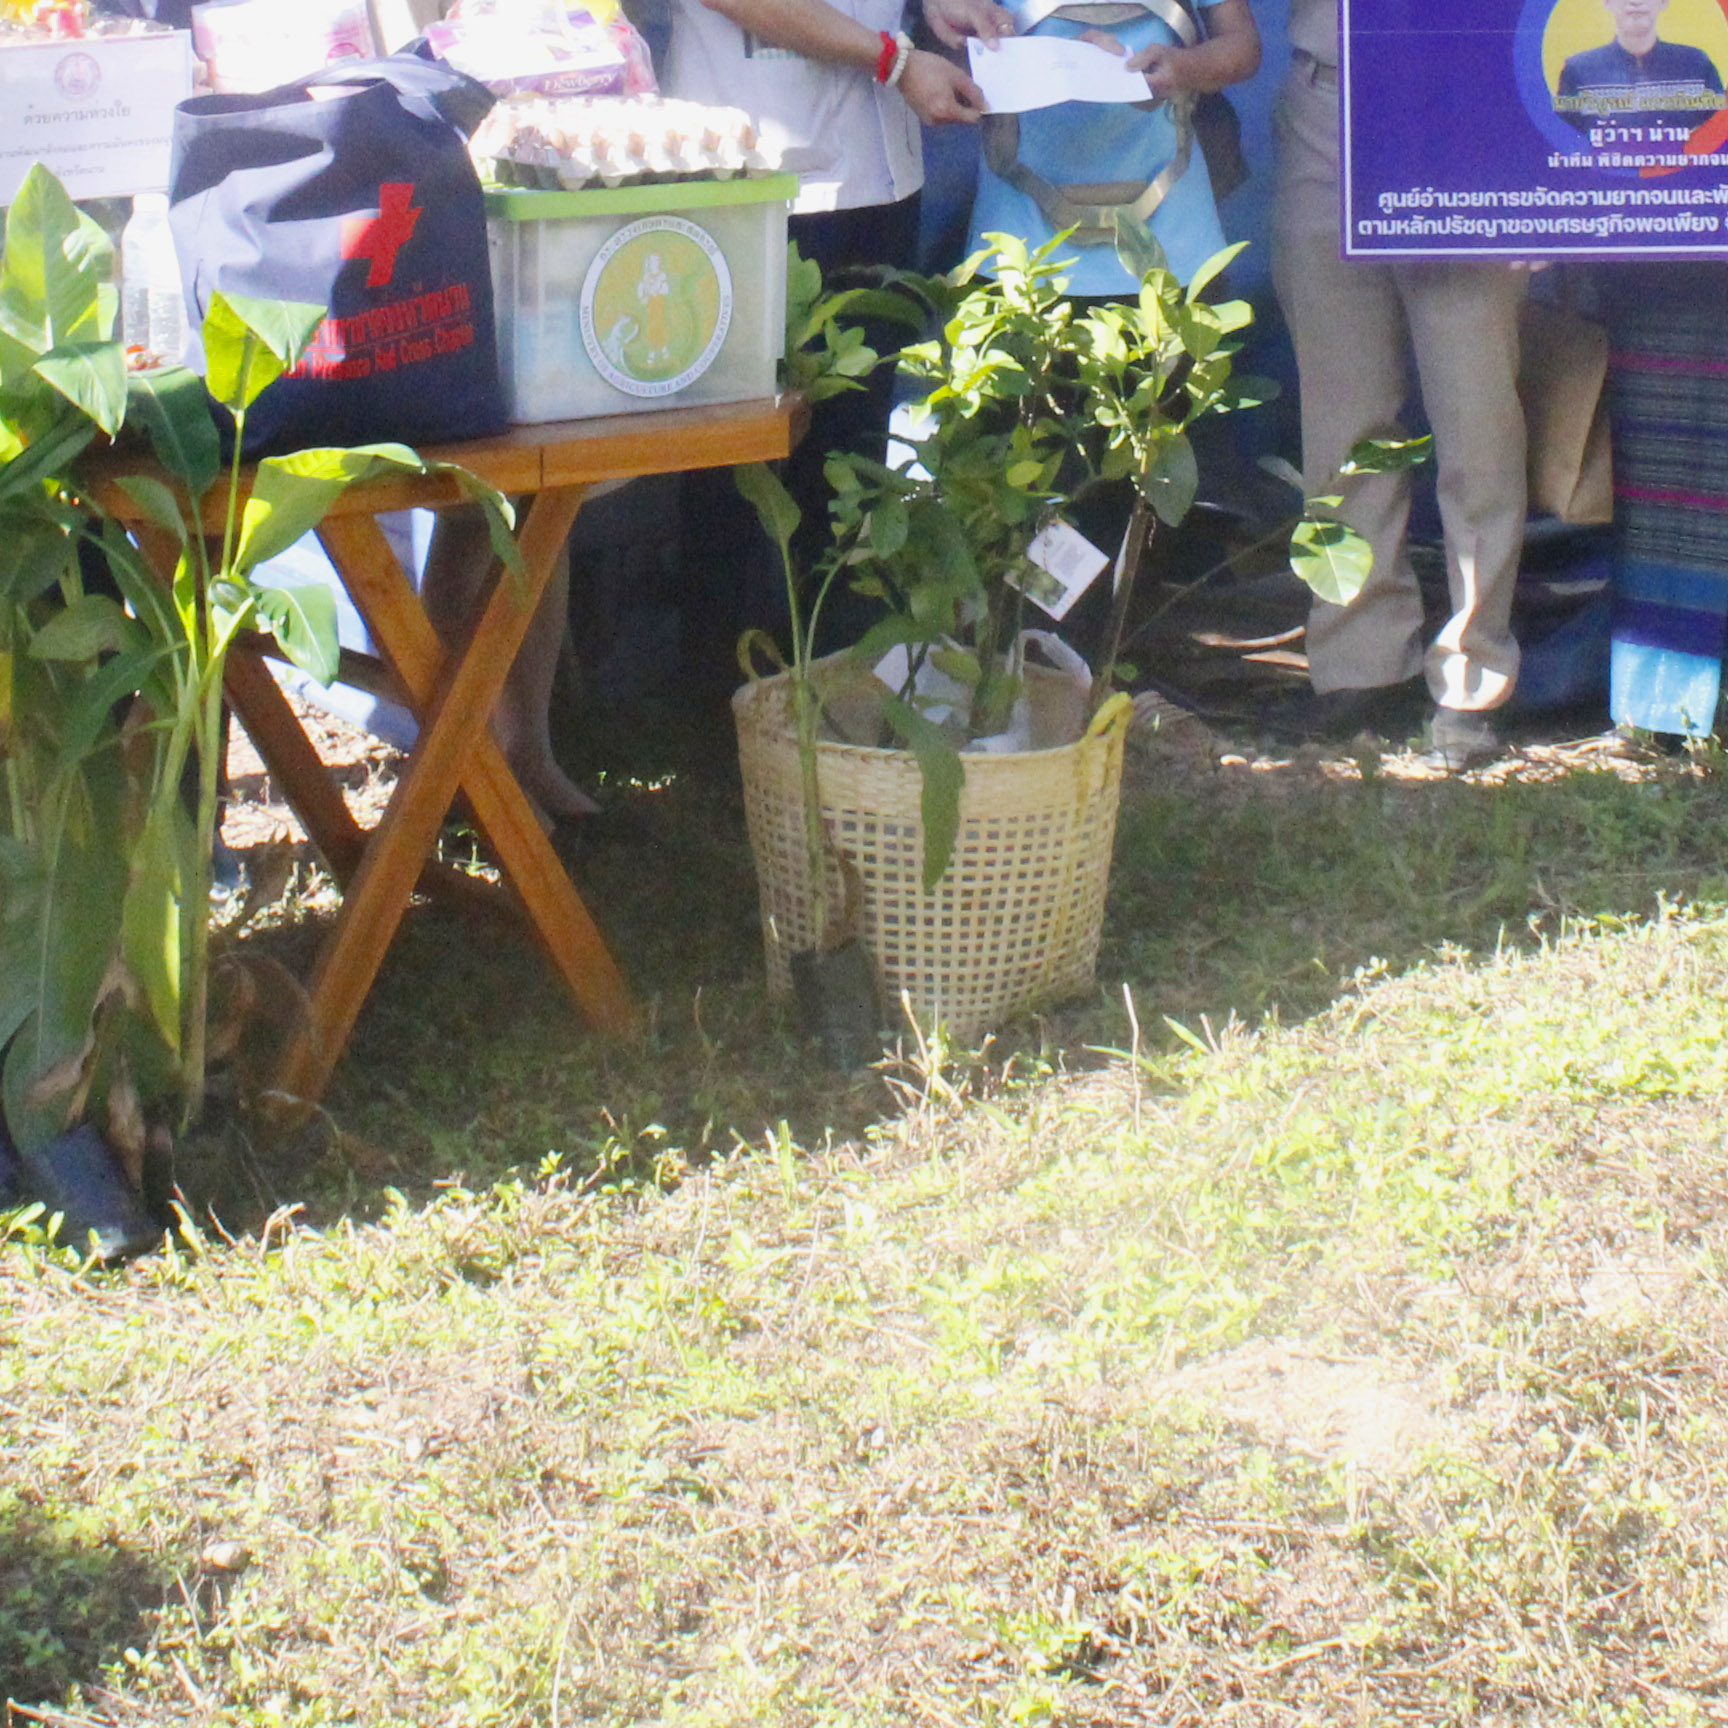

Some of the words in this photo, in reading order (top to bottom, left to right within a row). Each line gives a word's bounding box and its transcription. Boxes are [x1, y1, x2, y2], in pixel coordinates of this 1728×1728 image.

[1589, 119, 1642, 147] ผู้ว่าฯ
[1648, 119, 1690, 141] น่าน
[1358, 211, 1719, 237] ตามหลักปรัชญาของเศรษฐกิจพอเพียง
